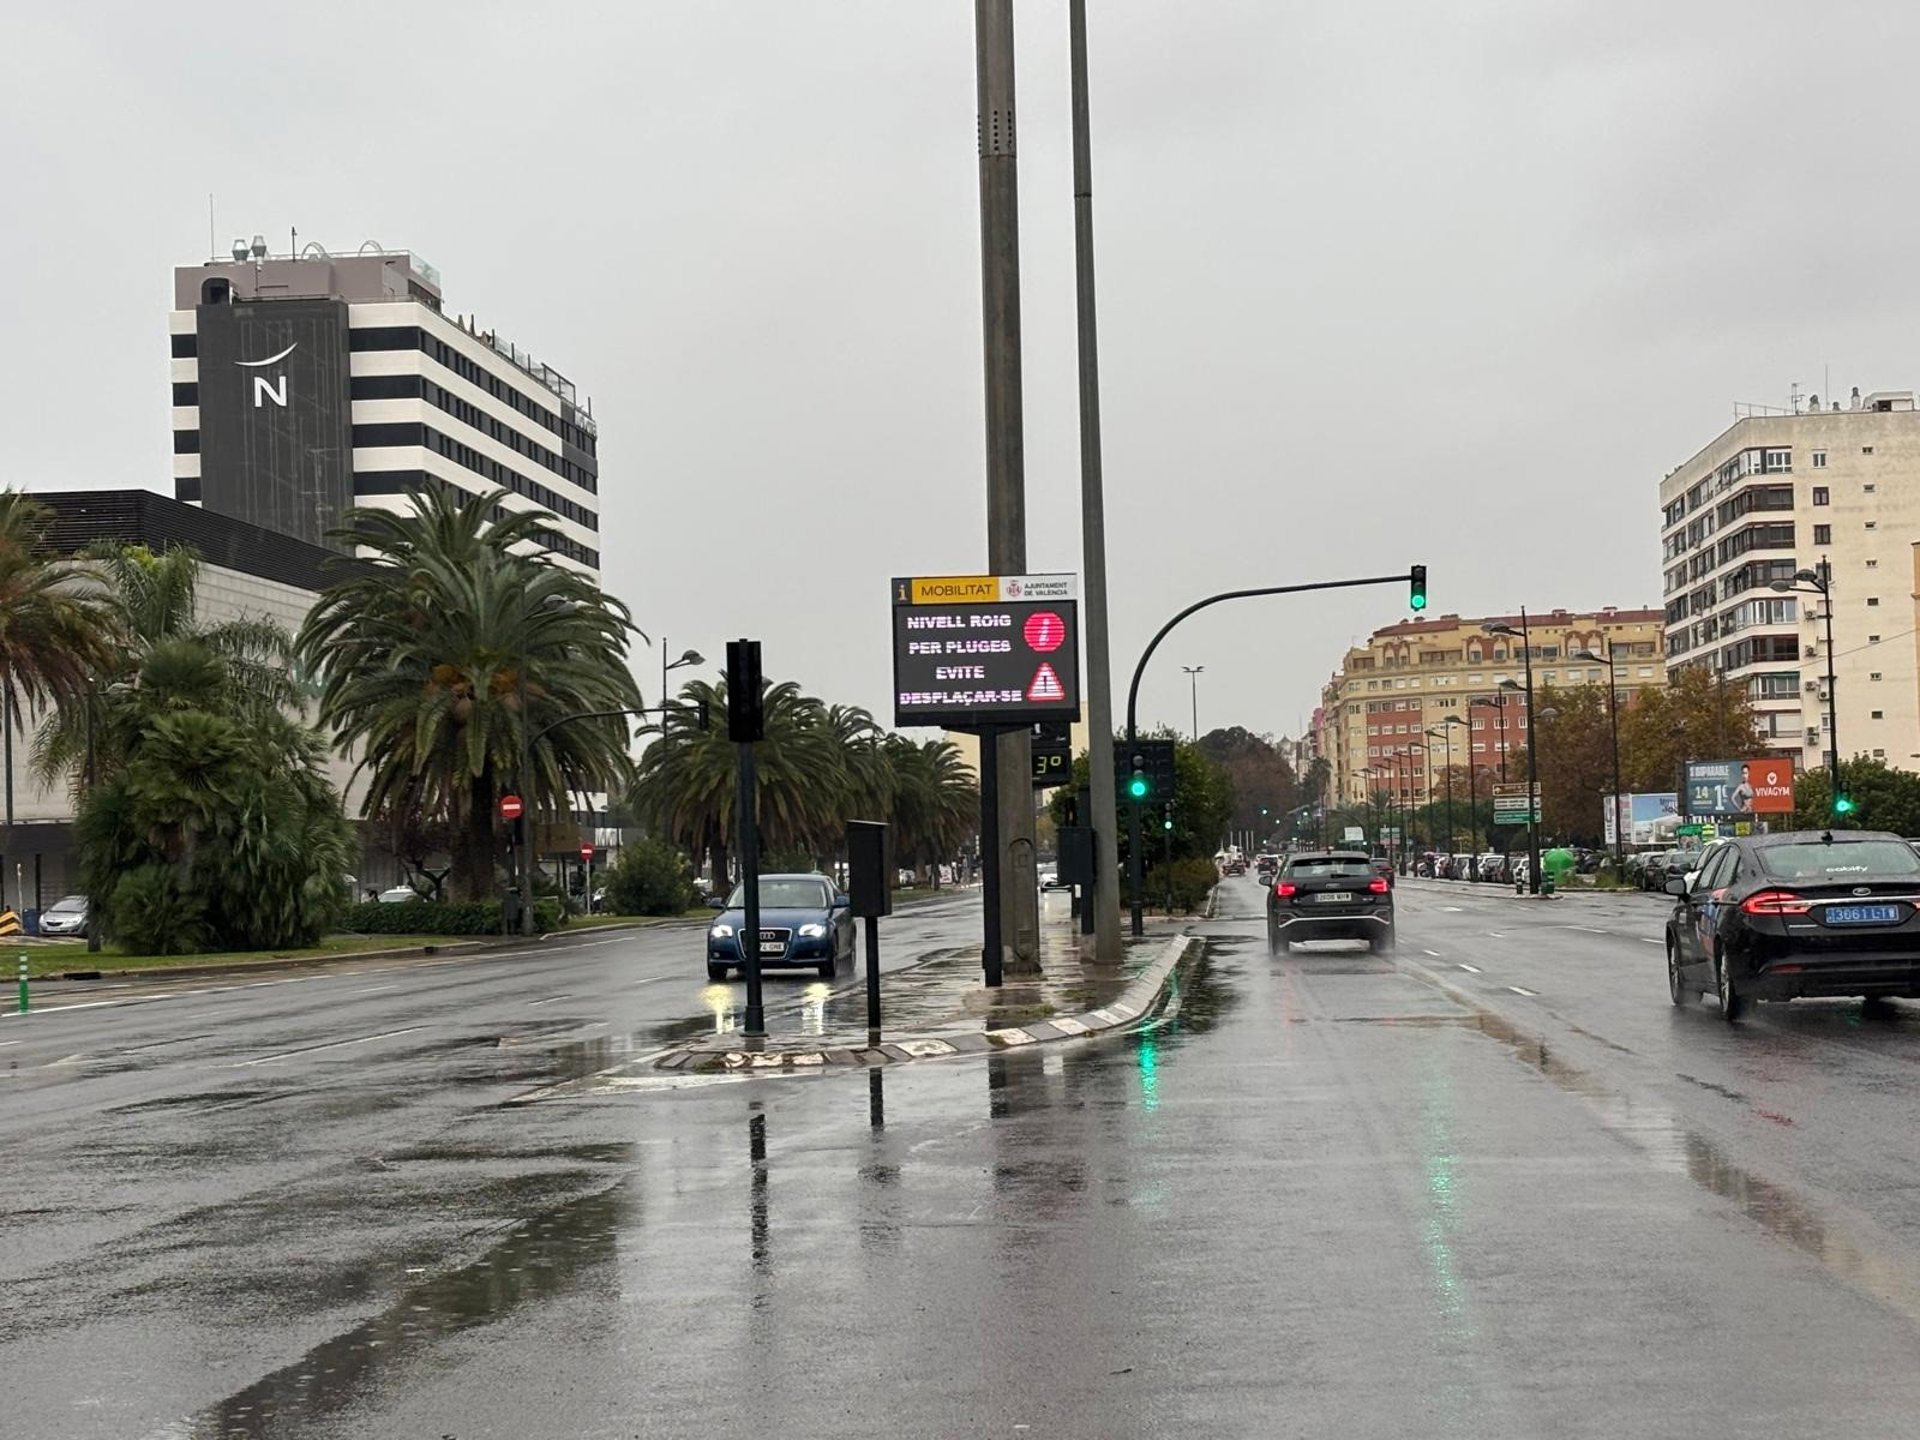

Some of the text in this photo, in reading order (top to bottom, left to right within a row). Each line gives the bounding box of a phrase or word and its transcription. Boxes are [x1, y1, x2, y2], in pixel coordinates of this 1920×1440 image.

[254, 376, 287, 407] N
[921, 584, 992, 597] MOBILITAT
[907, 615, 1011, 629] NIVELL ROIG
[909, 640, 1011, 654] PER PLUGES
[936, 665, 985, 679] EVITE
[900, 690, 1022, 706] DESPLAÇAR-SE
[1755, 786, 1790, 797] VIVAGYM
